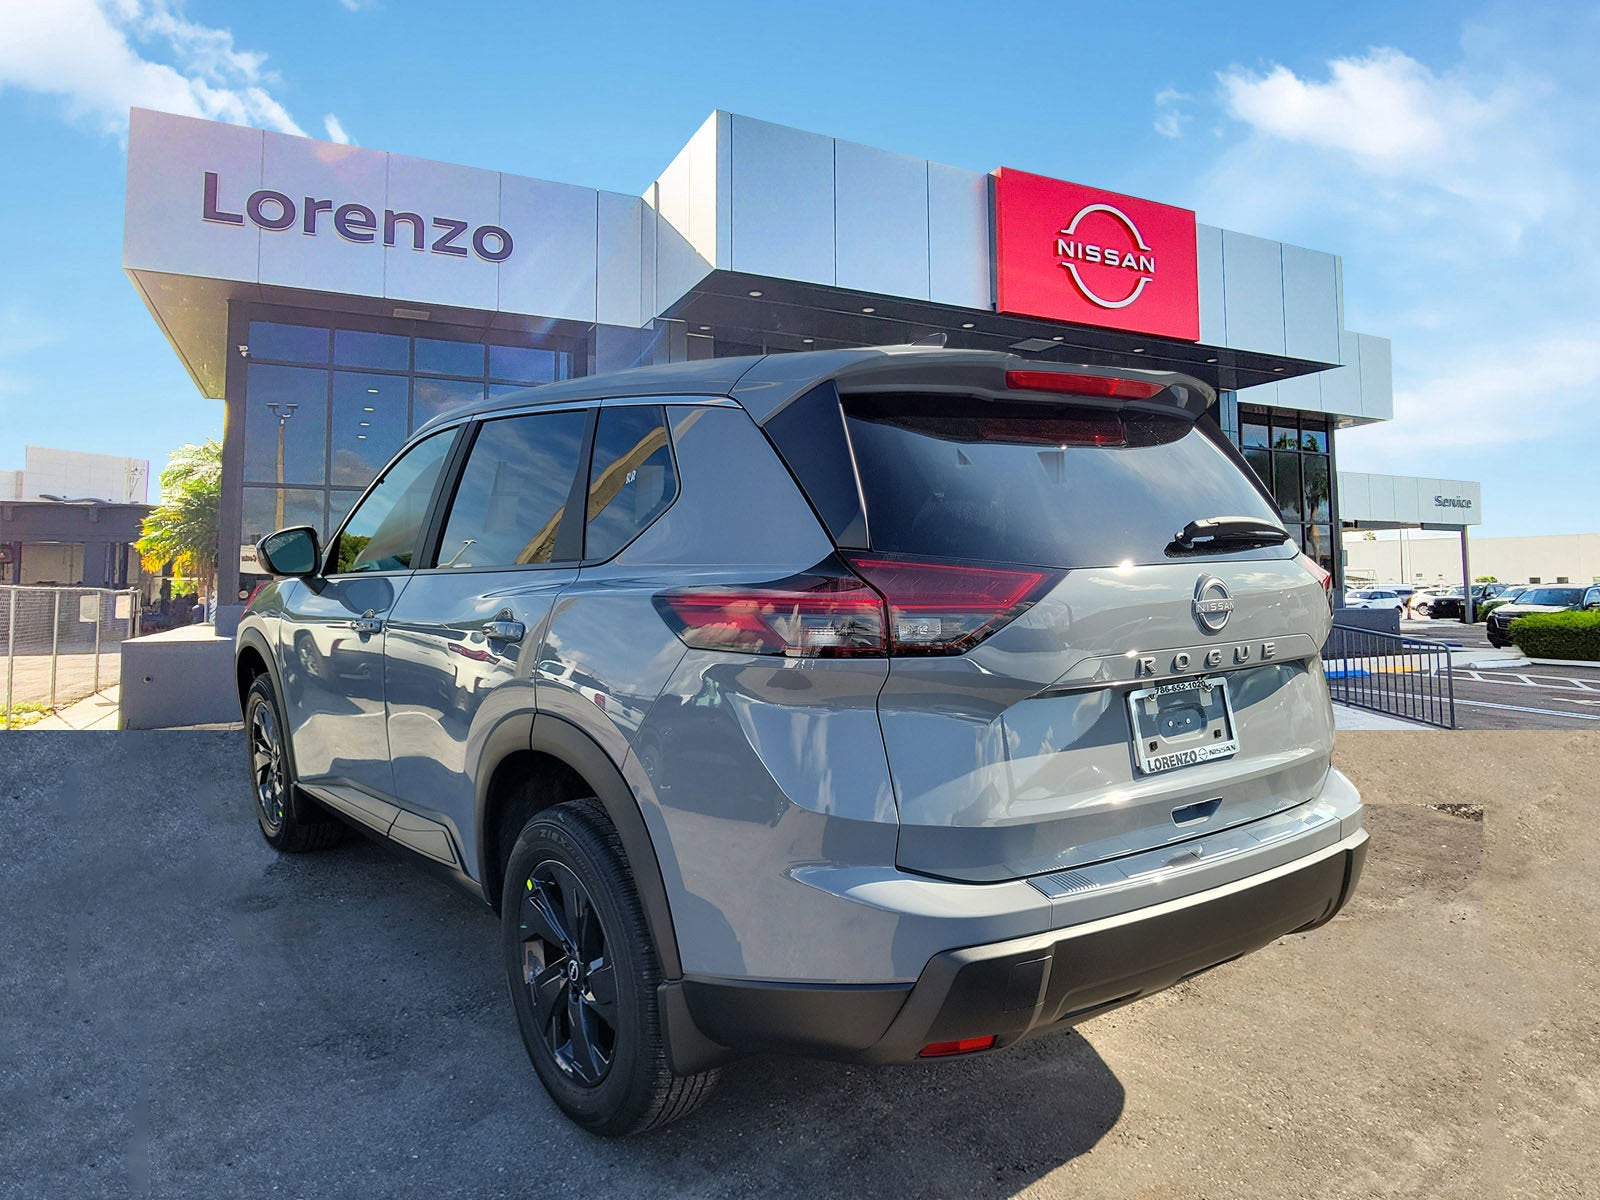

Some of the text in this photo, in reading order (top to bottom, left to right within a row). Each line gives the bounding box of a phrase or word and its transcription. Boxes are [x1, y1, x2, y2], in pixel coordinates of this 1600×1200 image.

[202, 171, 515, 262] Lorenzo
[1057, 238, 1155, 273] NISSAN
[1434, 495, 1472, 508] Service
[1196, 602, 1235, 613] NISSAN
[1138, 642, 1276, 675] ROGUE
[1154, 680, 1206, 694] 786-652-1020
[1147, 744, 1237, 773] LORENZO NISSAN
